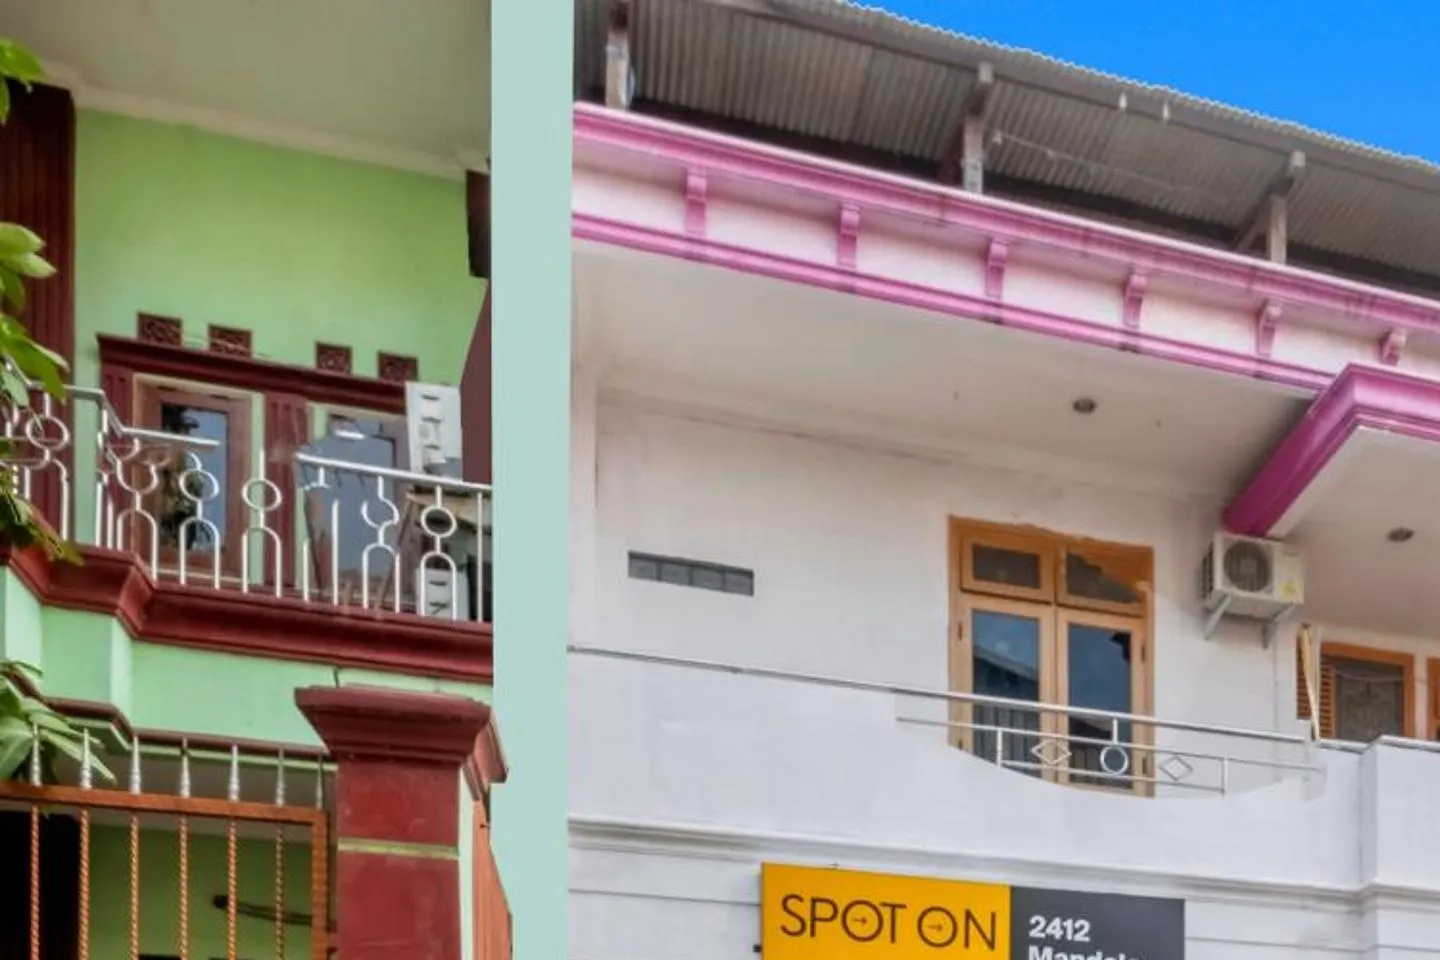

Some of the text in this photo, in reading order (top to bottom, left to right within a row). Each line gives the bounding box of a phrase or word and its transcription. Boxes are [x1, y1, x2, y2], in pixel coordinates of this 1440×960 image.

[779, 892, 997, 952] SPOT ON
[1028, 914, 1091, 943] 2412
